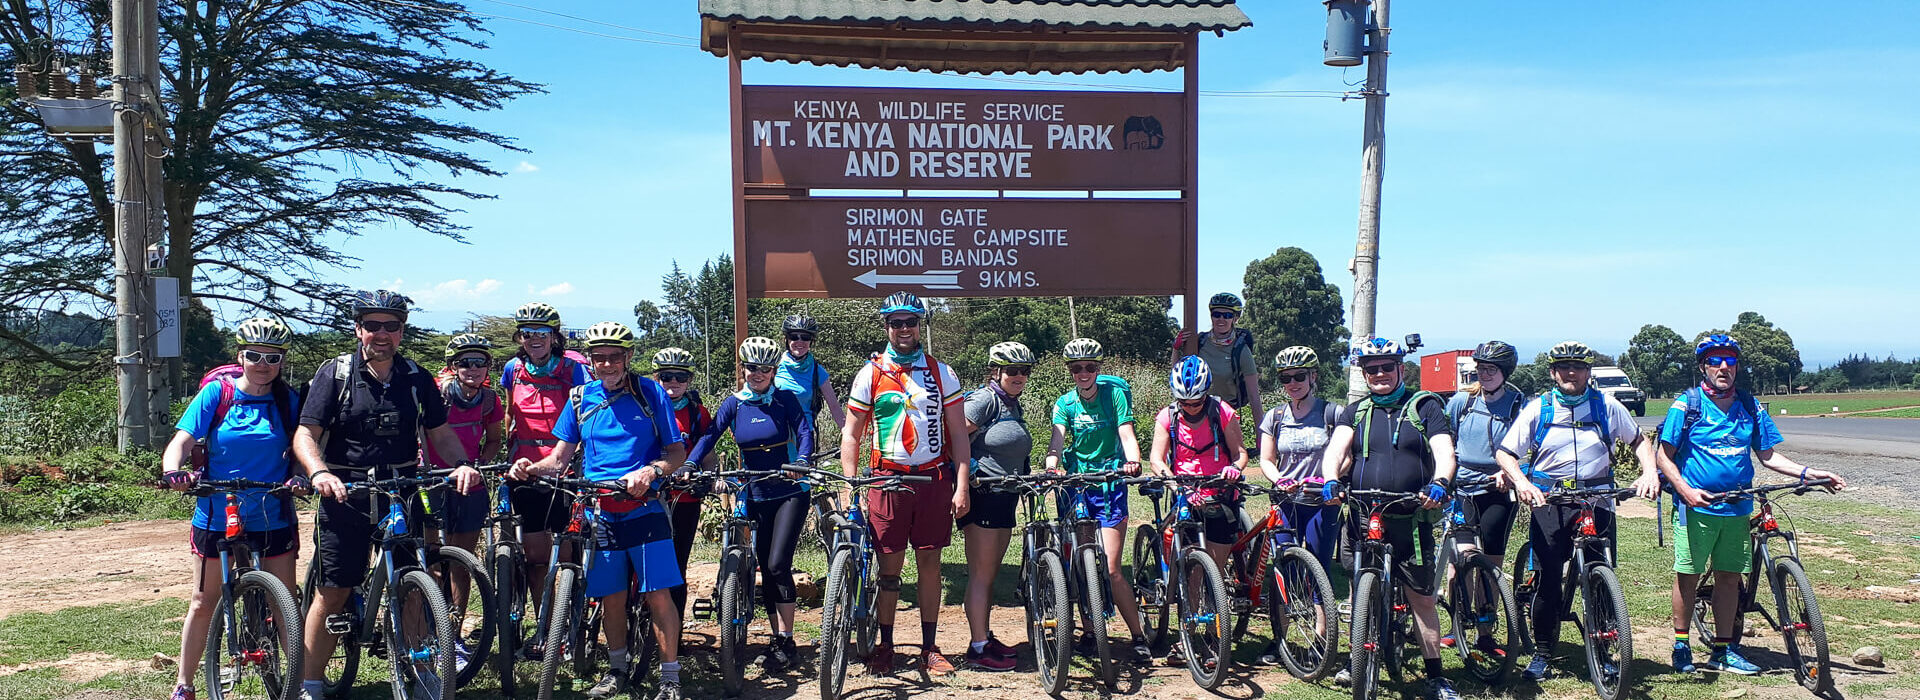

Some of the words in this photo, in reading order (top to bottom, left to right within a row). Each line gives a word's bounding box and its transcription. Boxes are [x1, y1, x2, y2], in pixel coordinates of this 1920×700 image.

[794, 100, 861, 119] KENYA
[878, 101, 966, 120] WILDLIFE
[983, 103, 1065, 121] SERVICE
[752, 120, 796, 147] MT.
[806, 121, 895, 149] KENYA
[908, 122, 1033, 150] NATIONAL
[1047, 124, 1115, 150] PARK
[844, 150, 900, 177] AND
[909, 151, 1032, 178] RESERVE
[846, 208, 923, 226] SIRIMON
[940, 208, 988, 227] GATE
[847, 228, 956, 246] MATHENGE
[973, 229, 1069, 247] CAMPSITE
[847, 248, 924, 267] SIRIMON
[941, 248, 1018, 267] BANDAS
[979, 270, 1040, 288] 9KMS.
[923, 370, 939, 416] FLAKES
[927, 418, 940, 454] CORN
